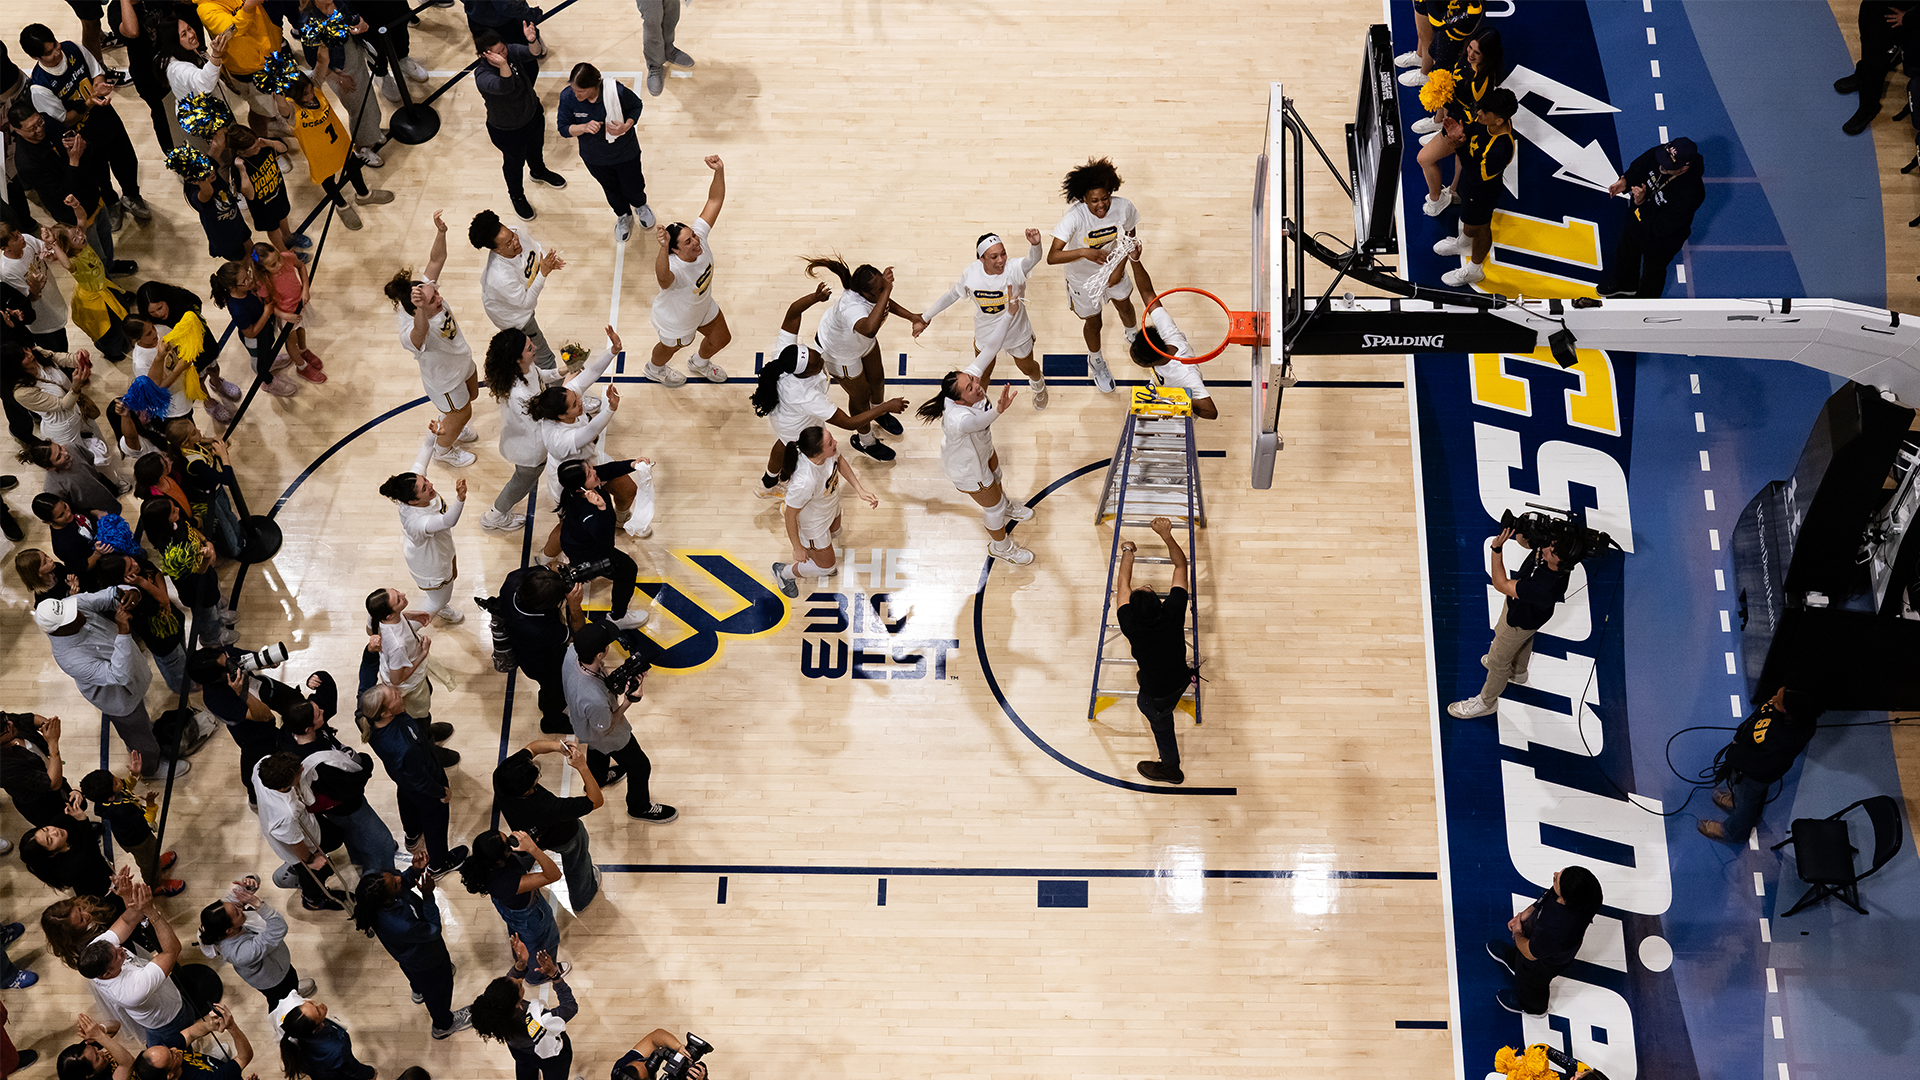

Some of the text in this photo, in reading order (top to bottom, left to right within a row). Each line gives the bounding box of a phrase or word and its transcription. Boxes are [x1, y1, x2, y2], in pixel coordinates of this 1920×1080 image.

[325, 123, 338, 144] 1
[1361, 333, 1444, 348] SPALDING
[801, 638, 959, 680] WEST
